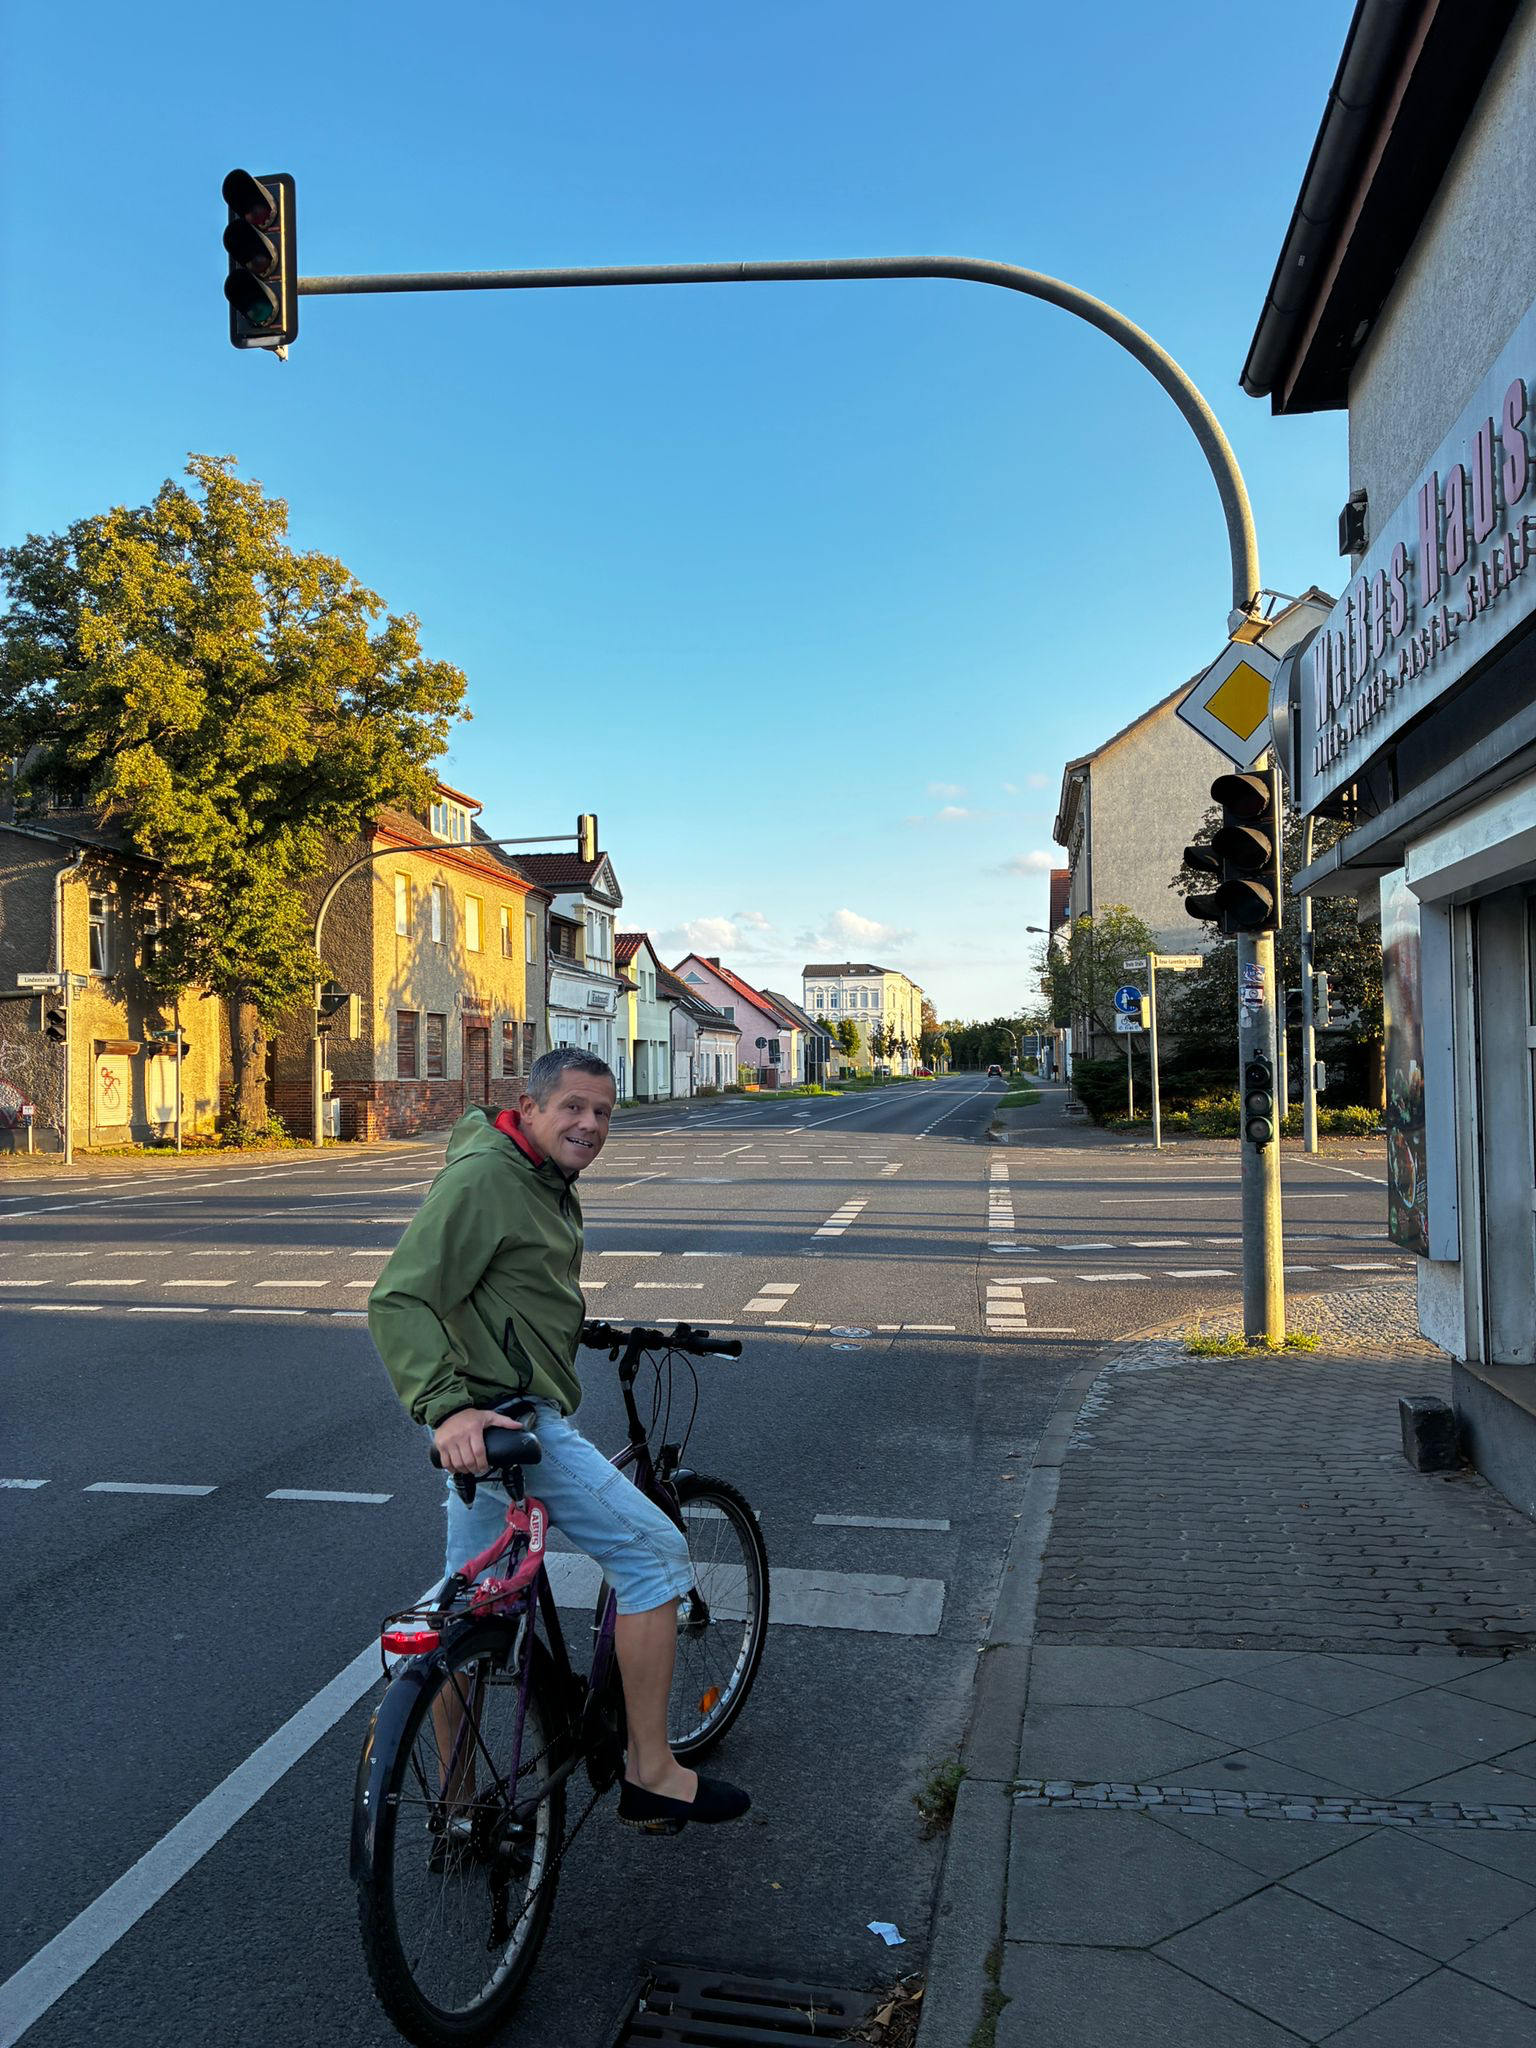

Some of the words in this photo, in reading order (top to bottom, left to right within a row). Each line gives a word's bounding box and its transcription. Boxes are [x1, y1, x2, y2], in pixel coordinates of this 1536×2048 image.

[1418, 378, 1529, 608] Haus
[1347, 669, 1387, 743] BURGER
[1398, 605, 1449, 689] PASTA
[1466, 515, 1529, 622] SALAT
[531, 1513, 540, 1546] ABUS
